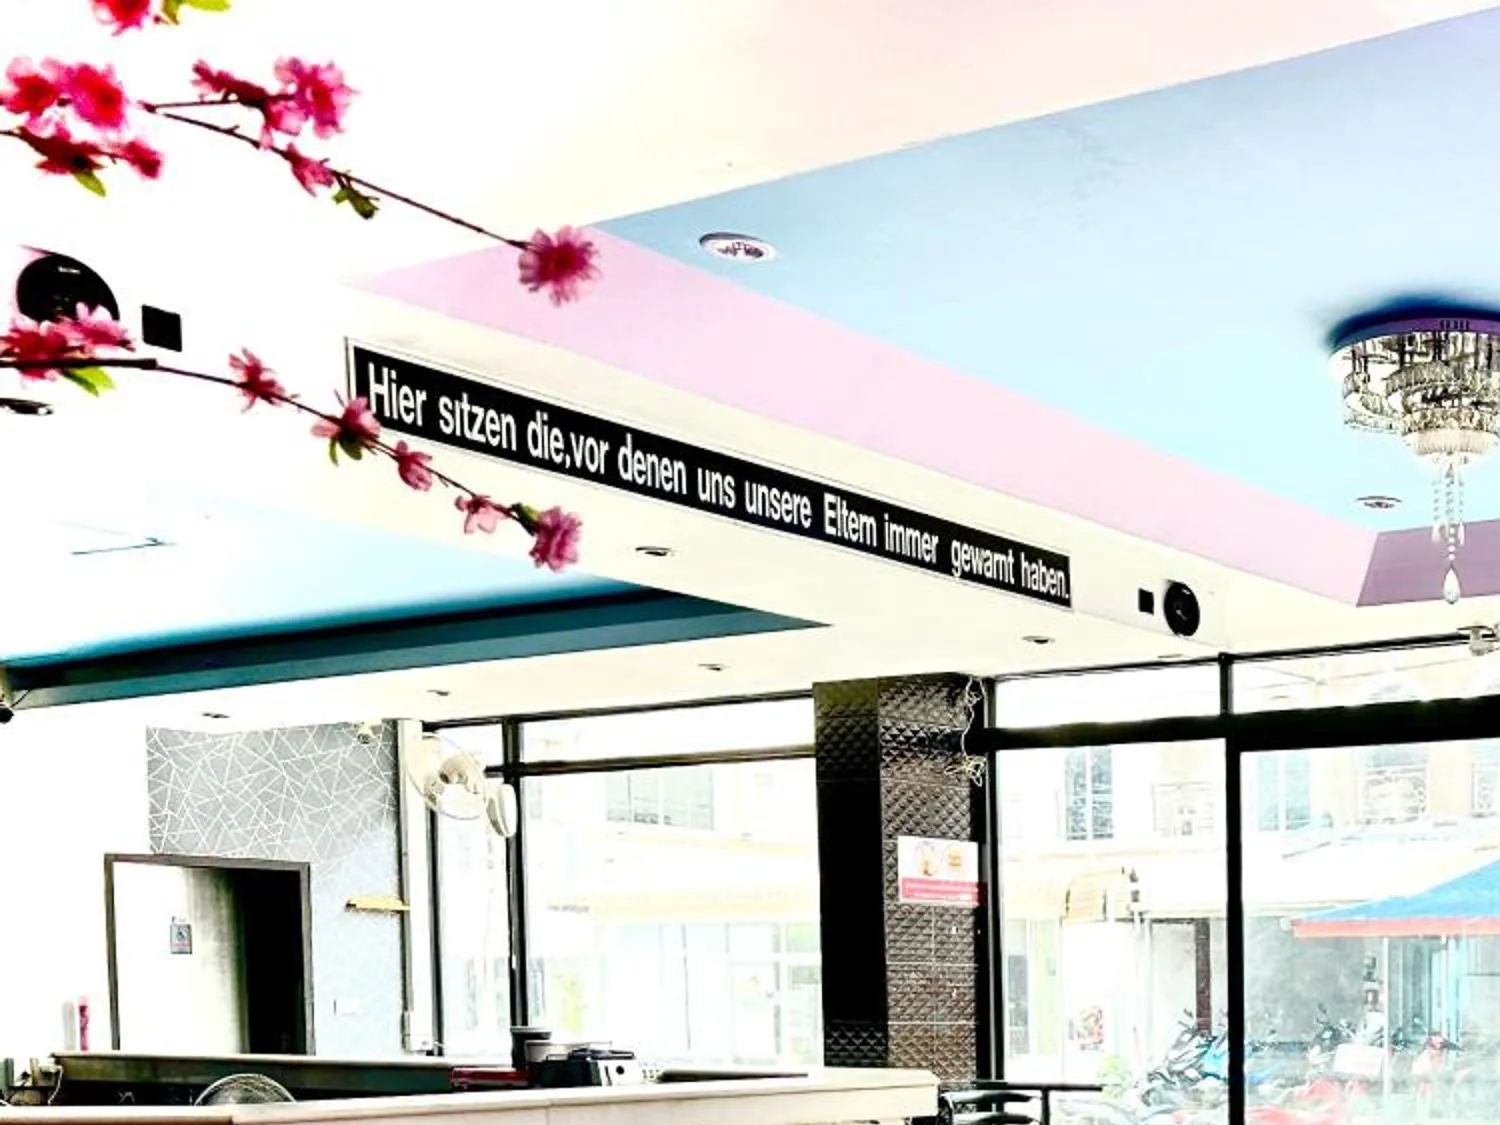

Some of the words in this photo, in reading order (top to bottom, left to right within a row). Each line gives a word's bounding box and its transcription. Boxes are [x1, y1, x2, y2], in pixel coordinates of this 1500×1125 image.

[368, 362, 428, 427] Hier
[617, 432, 687, 495] denen
[697, 467, 736, 509] uns
[744, 480, 812, 528] unsere
[823, 492, 878, 547] Eltern
[883, 513, 939, 564] immer
[951, 539, 1015, 580] gewarnt
[1020, 552, 1070, 599] haben.
